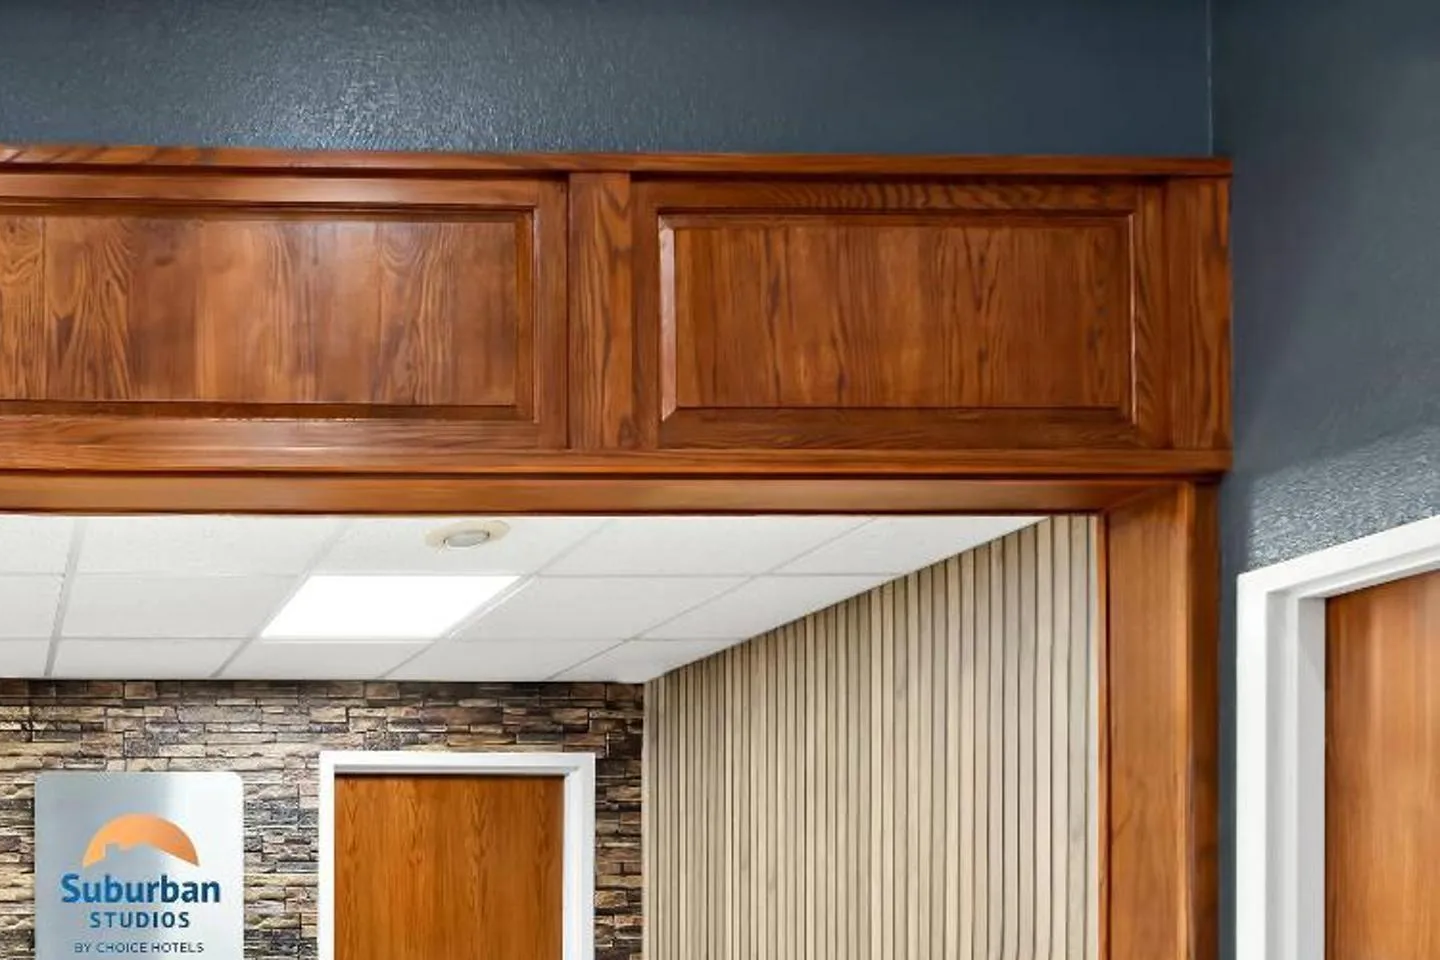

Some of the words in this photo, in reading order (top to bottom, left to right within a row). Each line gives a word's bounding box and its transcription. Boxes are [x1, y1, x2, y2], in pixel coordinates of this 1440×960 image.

[60, 873, 221, 904] Suburban
[89, 911, 190, 928] STUDIOS
[74, 942, 91, 953] BY
[96, 942, 147, 953] CHOICE
[151, 942, 204, 953] HOTELS
